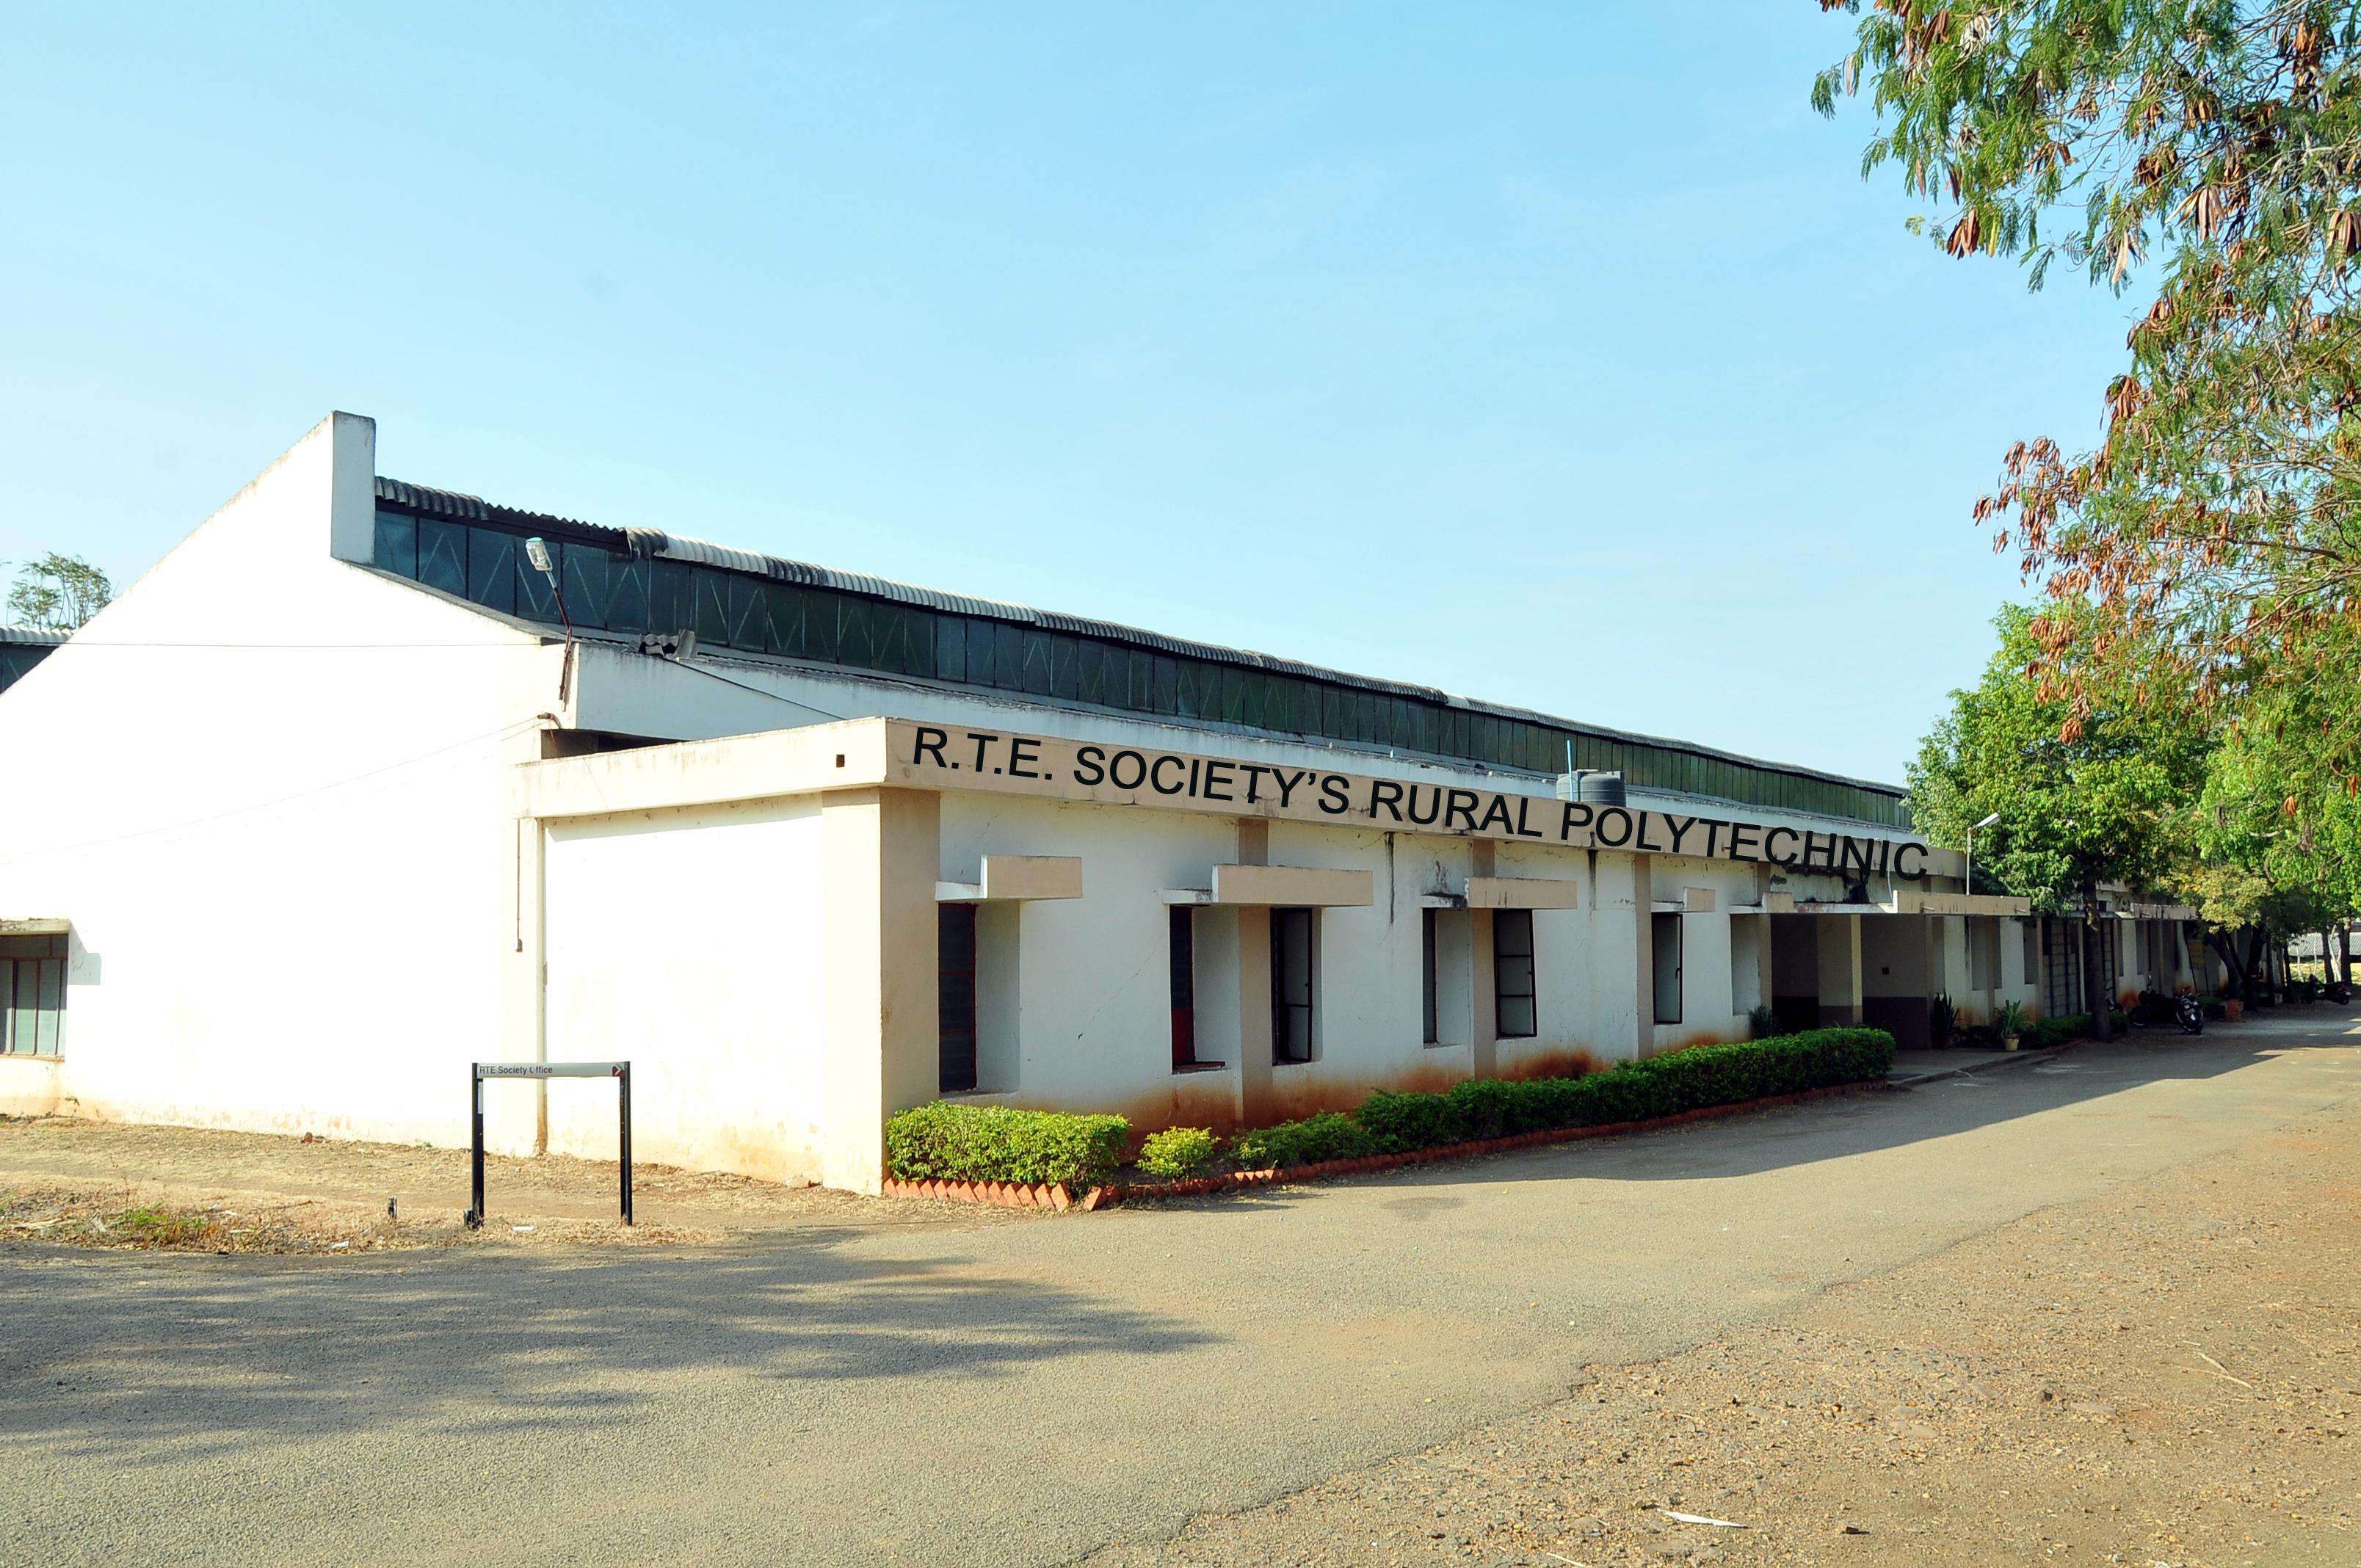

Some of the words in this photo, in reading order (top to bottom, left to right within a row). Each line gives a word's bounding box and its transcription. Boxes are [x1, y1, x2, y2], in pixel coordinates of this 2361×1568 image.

[913, 727, 1053, 780] R.T.E.
[1073, 746, 1350, 814] SOCIETY'S
[1369, 780, 1542, 838] RURAL
[1561, 802, 1929, 882] POLYTECHNIC
[479, 1066, 496, 1074] RTE
[498, 1065, 527, 1075] Society
